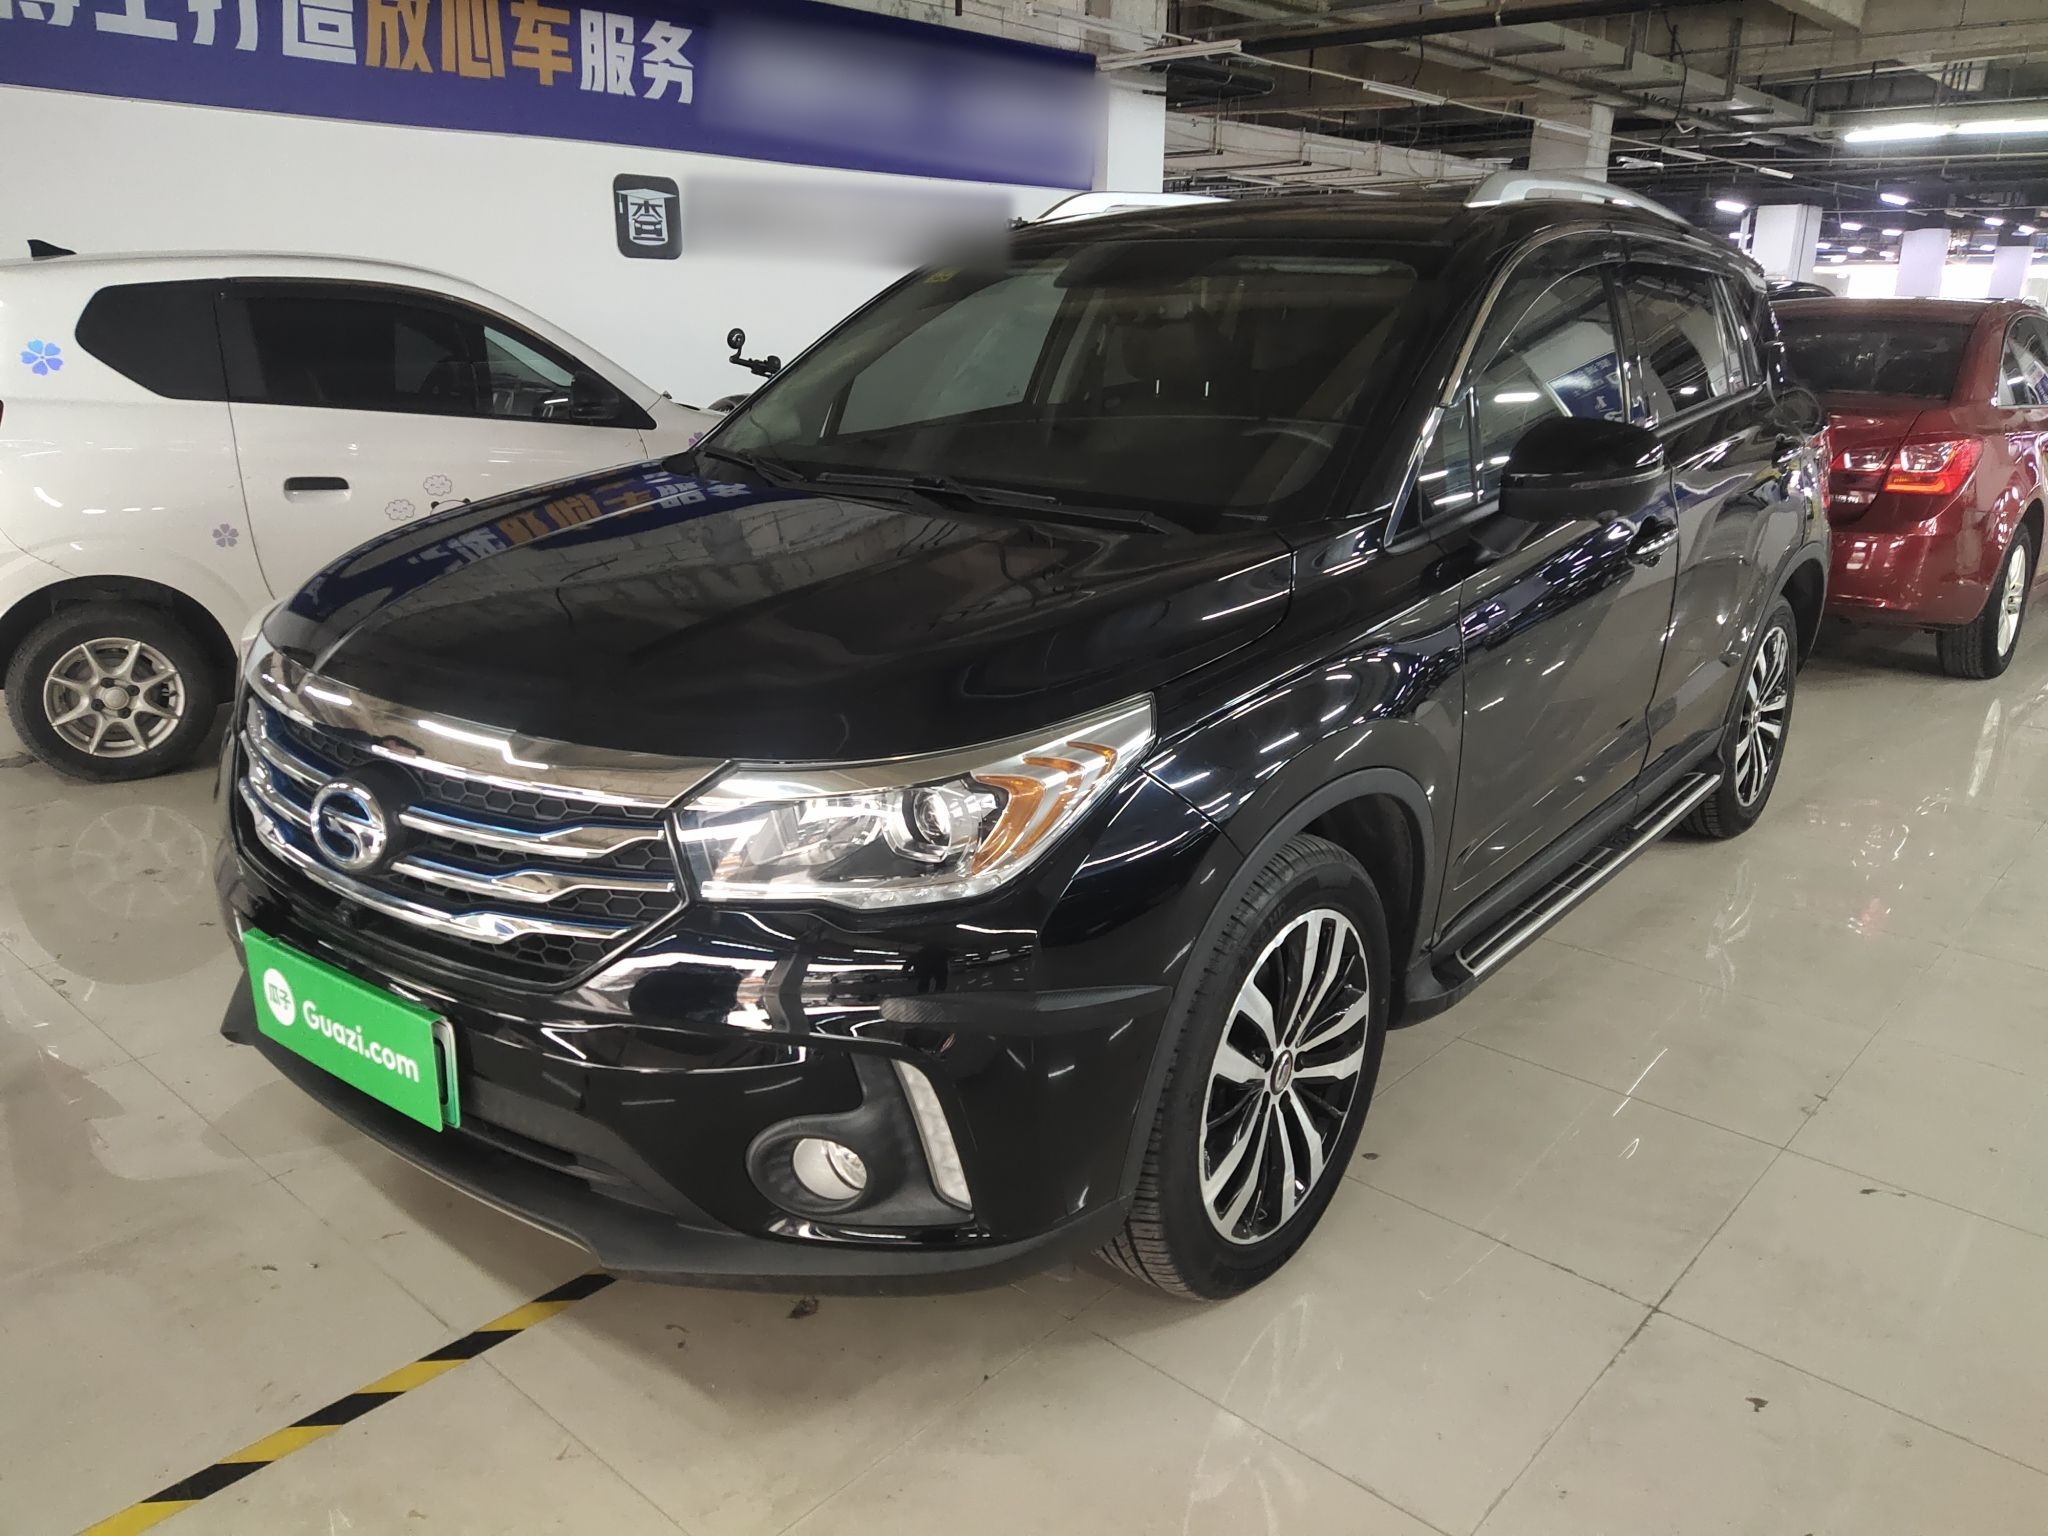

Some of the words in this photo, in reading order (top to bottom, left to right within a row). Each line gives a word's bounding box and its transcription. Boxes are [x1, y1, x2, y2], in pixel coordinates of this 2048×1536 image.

[0, 0, 694, 104] 打造放心车服务
[302, 1000, 420, 1083] Guazi.com
